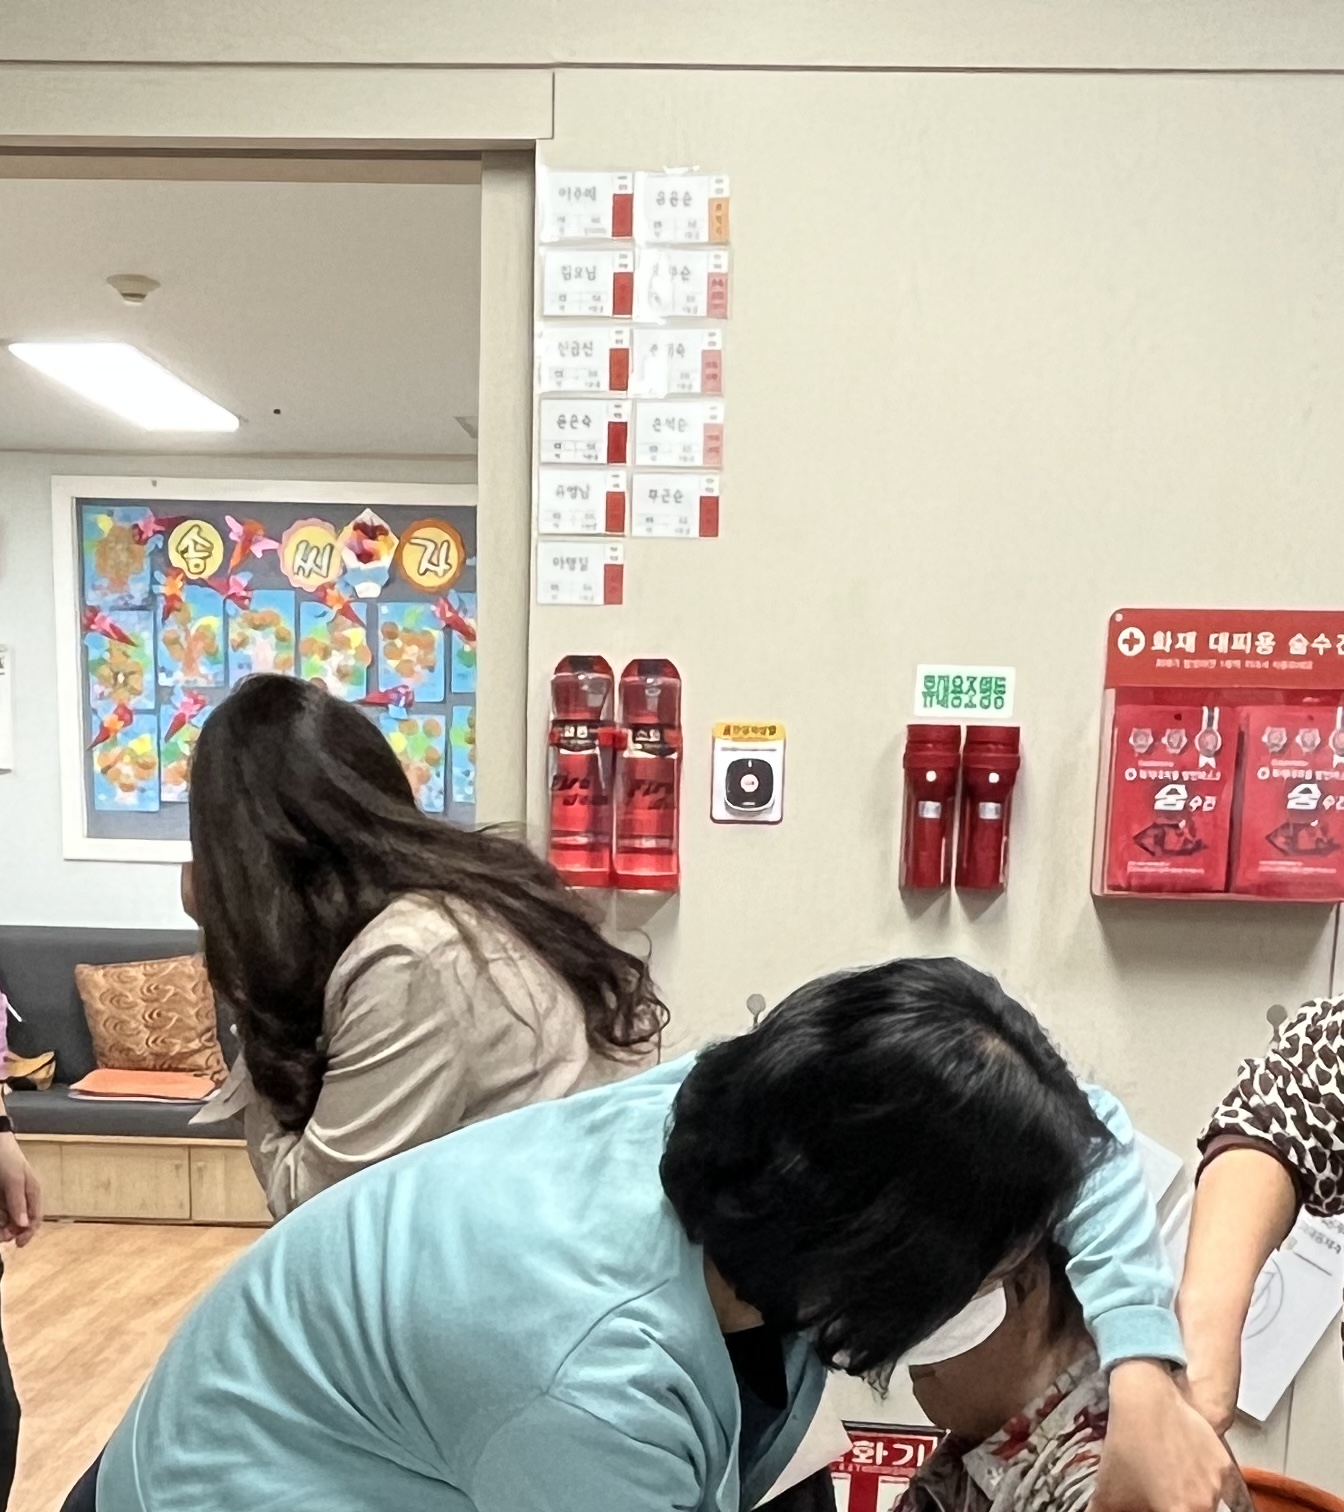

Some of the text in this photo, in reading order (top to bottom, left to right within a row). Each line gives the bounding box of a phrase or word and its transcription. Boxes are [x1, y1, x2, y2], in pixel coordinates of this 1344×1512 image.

[1151, 630, 1197, 653] 화재
[1208, 631, 1276, 655] 대피용
[833, 1440, 925, 1466] 화기
